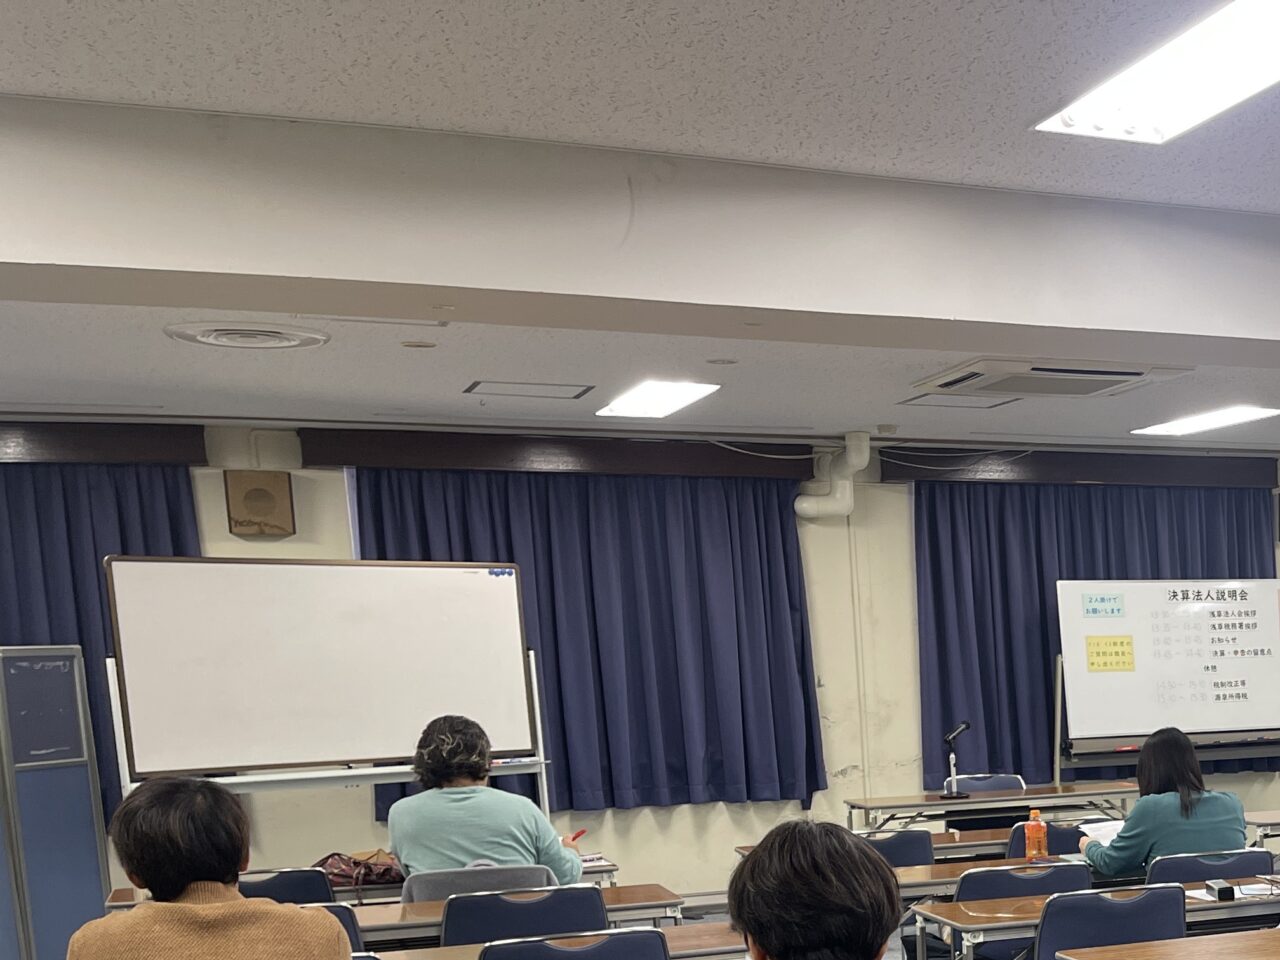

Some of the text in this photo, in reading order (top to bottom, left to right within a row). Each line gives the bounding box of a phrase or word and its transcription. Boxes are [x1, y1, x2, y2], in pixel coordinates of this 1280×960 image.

[1168, 588, 1249, 602] 決算法人説明会
[1085, 607, 1121, 615] お願いします
[1209, 609, 1257, 618] 浅草法人会挨拶
[1210, 621, 1258, 631] 浅草税務署挨拶
[1210, 635, 1237, 645] お知らせ
[1203, 664, 1218, 673] 休憩
[1213, 679, 1246, 689] 税制改正等
[1214, 692, 1249, 701] 源泉所得税
